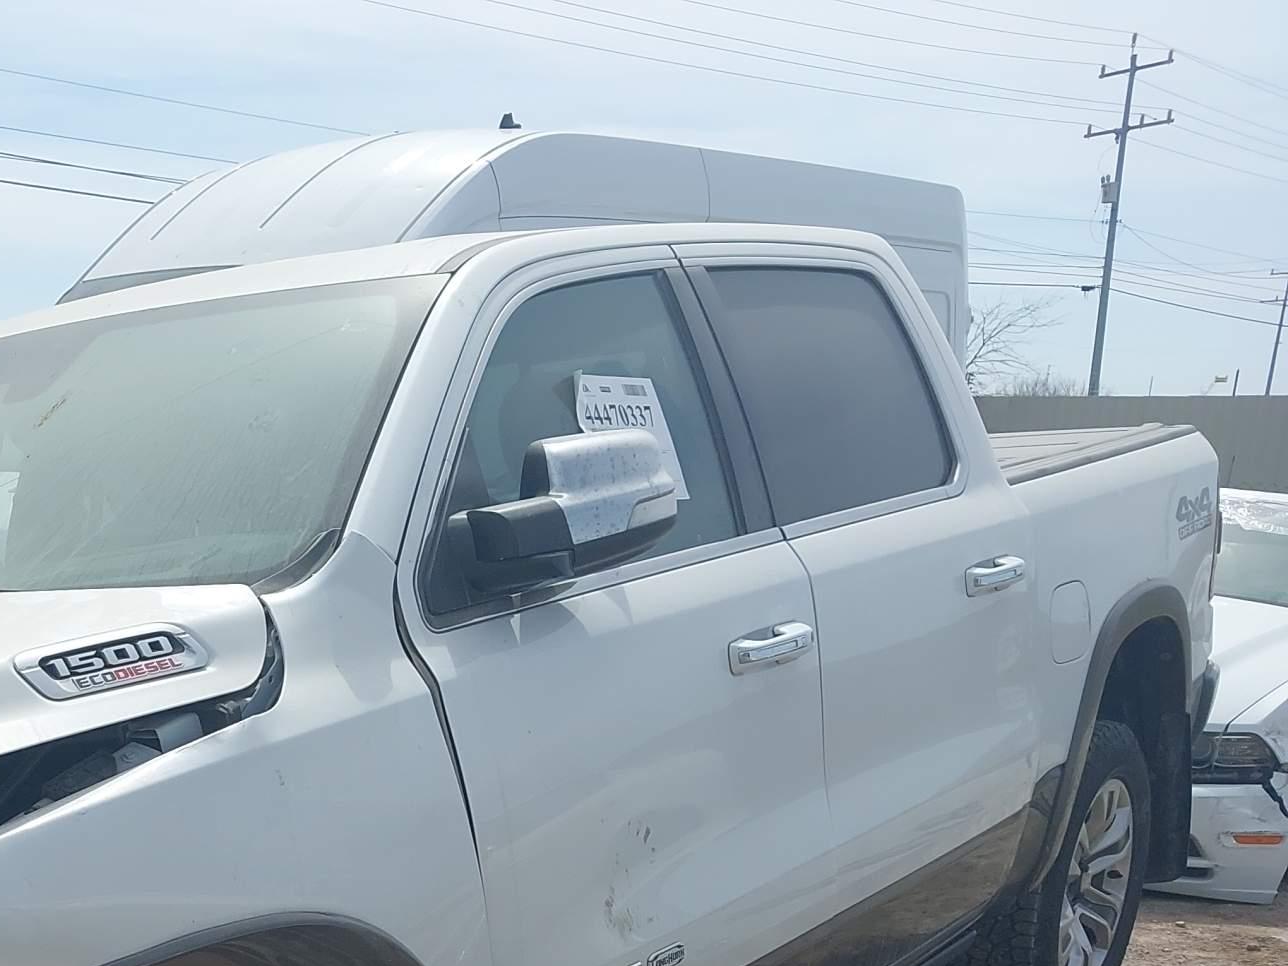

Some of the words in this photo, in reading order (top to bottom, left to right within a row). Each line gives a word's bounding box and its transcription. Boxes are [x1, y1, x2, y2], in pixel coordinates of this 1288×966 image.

[584, 403, 654, 427] 44470337
[45, 636, 173, 678] 1500
[73, 658, 183, 690] ECODIESEL
